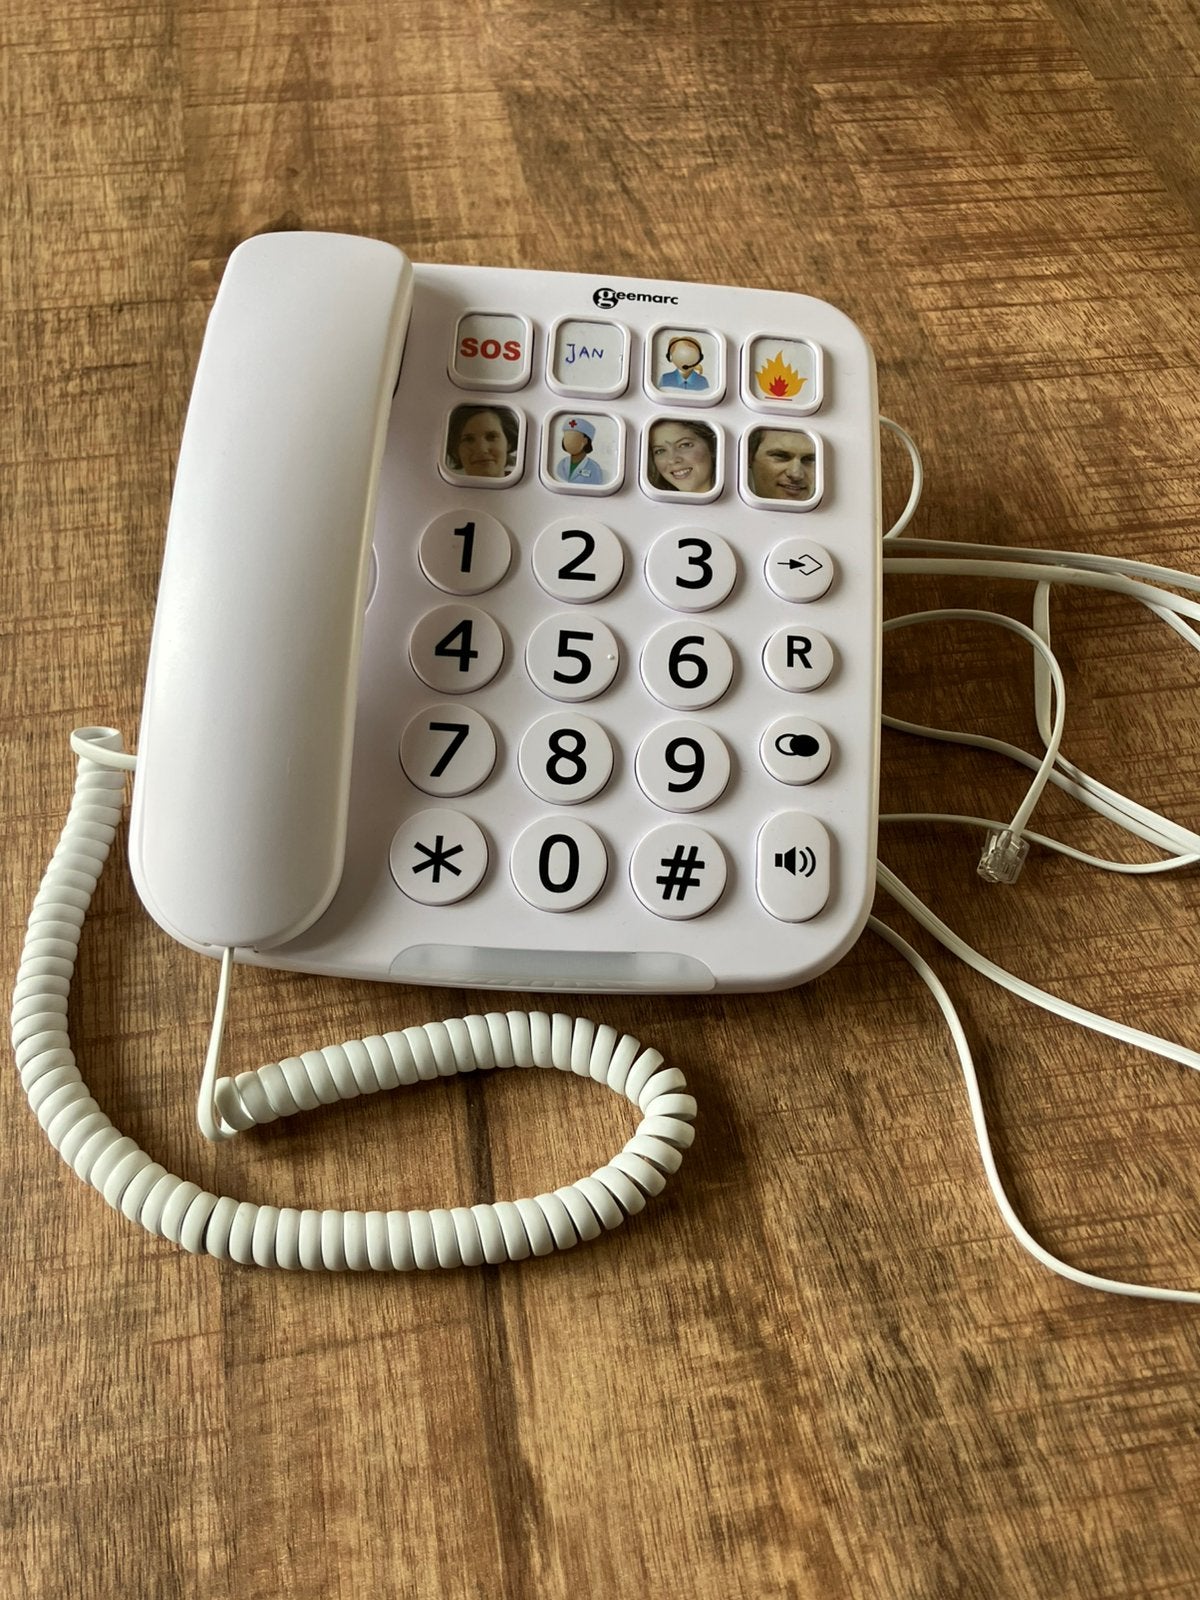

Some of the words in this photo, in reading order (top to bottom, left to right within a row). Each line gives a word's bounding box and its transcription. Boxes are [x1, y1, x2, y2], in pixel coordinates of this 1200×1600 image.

[593, 287, 679, 310] geemarc
[460, 337, 521, 361] SOS
[565, 343, 604, 364] JAN
[454, 522, 476, 573] 1
[558, 530, 596, 582] 2
[675, 538, 713, 589] 3
[434, 619, 478, 672] 4
[553, 630, 594, 684] 5
[668, 636, 708, 689] 6
[786, 636, 812, 669] R
[429, 722, 469, 778] 7
[546, 728, 587, 785] 8
[665, 737, 705, 793] 9
[538, 834, 580, 893] 0
